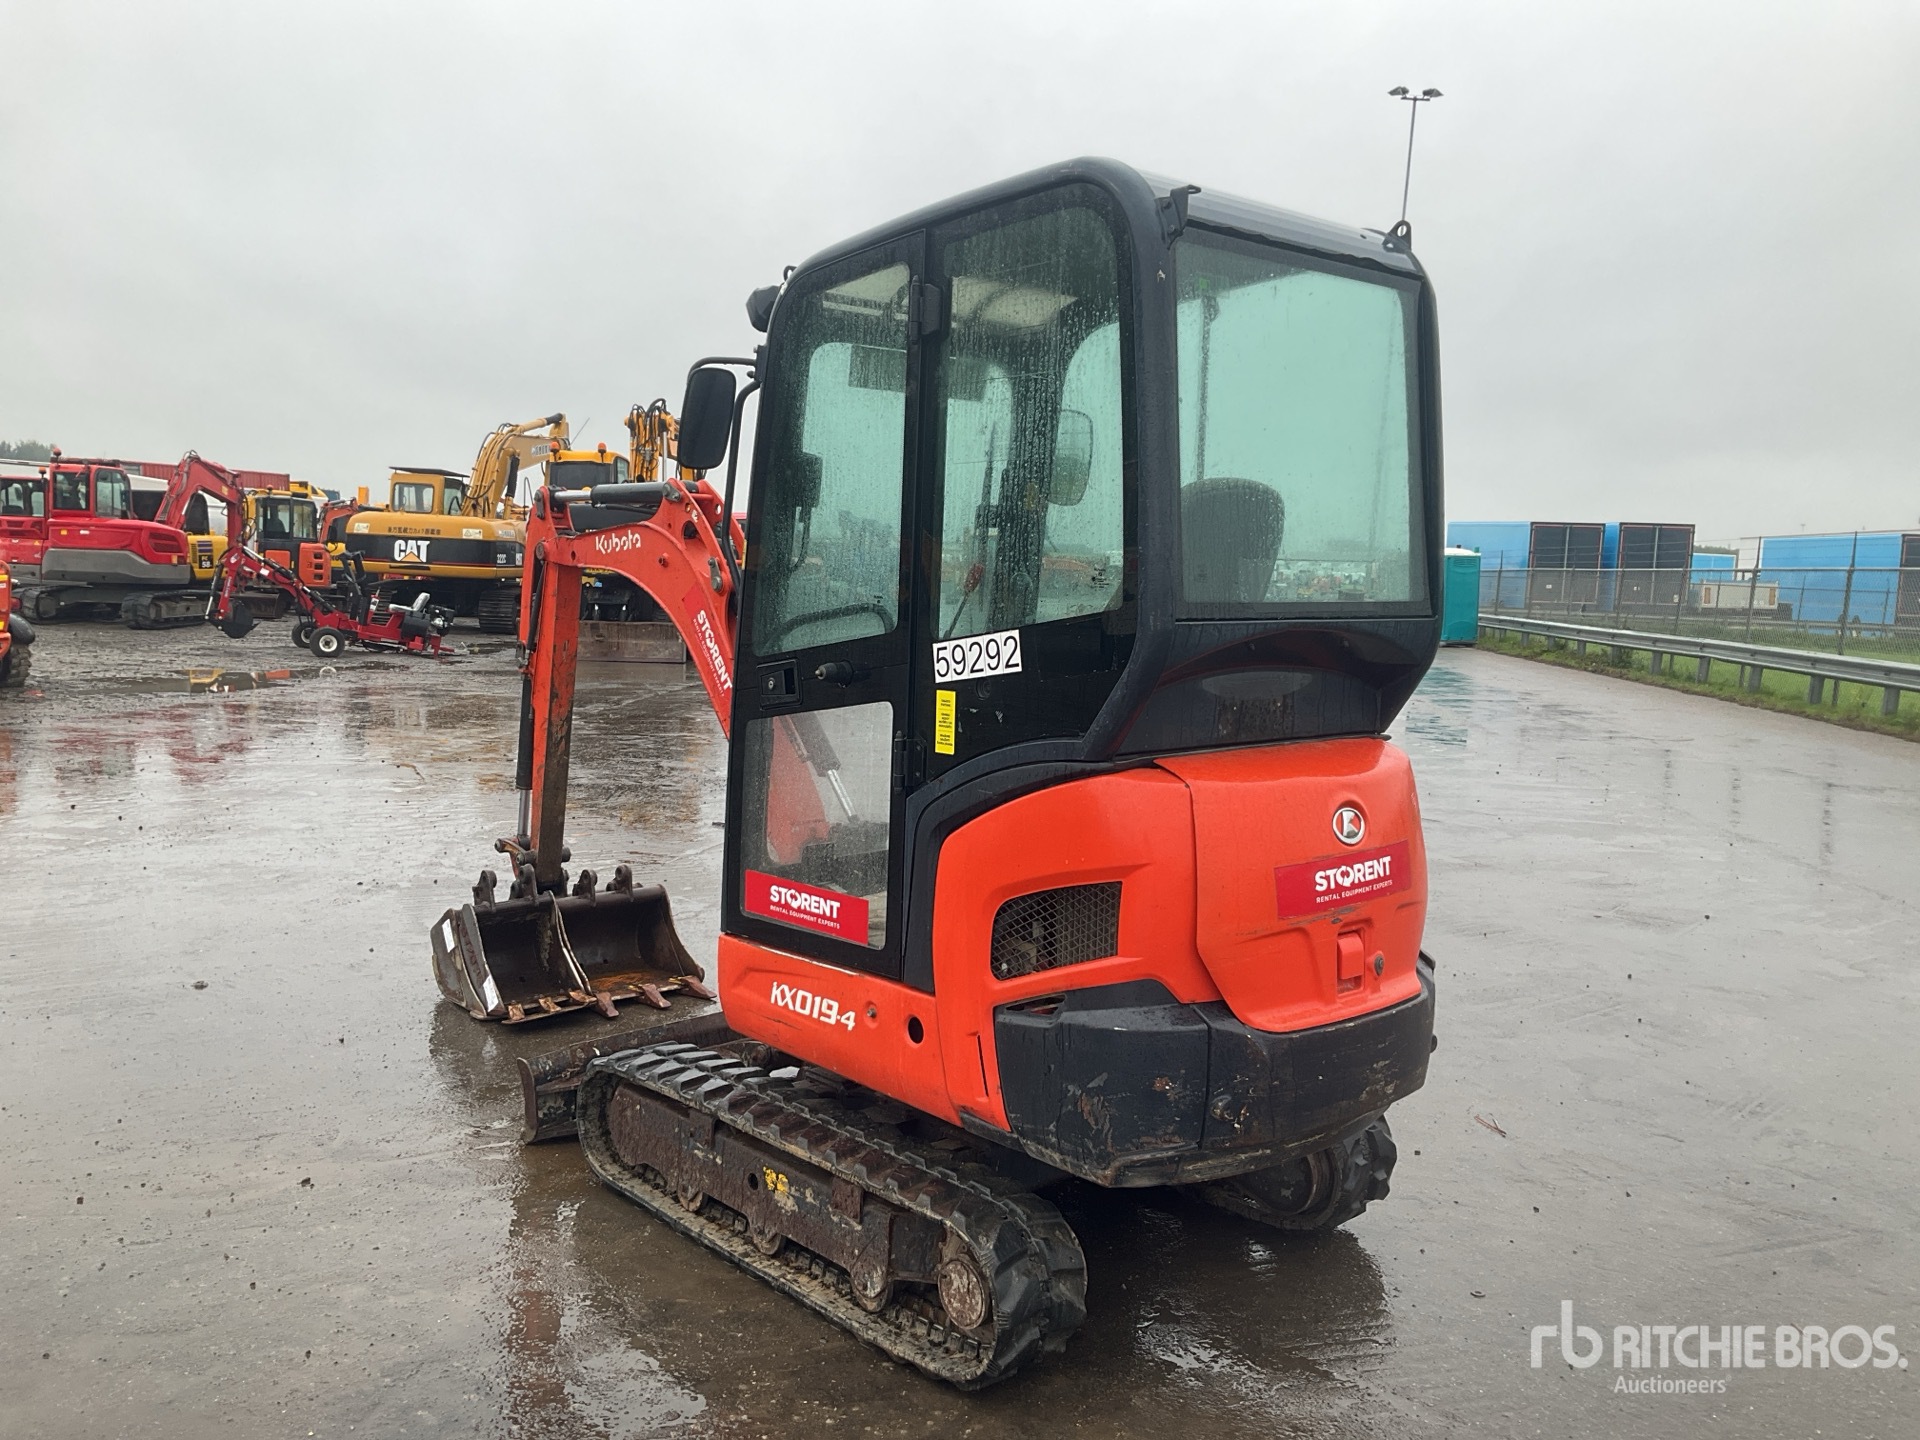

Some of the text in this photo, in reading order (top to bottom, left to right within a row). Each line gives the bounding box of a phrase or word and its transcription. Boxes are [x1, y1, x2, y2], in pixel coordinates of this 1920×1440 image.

[394, 539, 430, 563] CAT
[595, 529, 641, 554] Kubota
[697, 610, 733, 690] STORENT
[936, 635, 1020, 678] 59292
[1315, 855, 1392, 891] STORENT
[769, 885, 840, 919] STORENT
[1316, 879, 1393, 904] RENTAL EQUIPMENT EXPERTS
[769, 904, 840, 929] RENTAL EQUIPMENT EXPERTS
